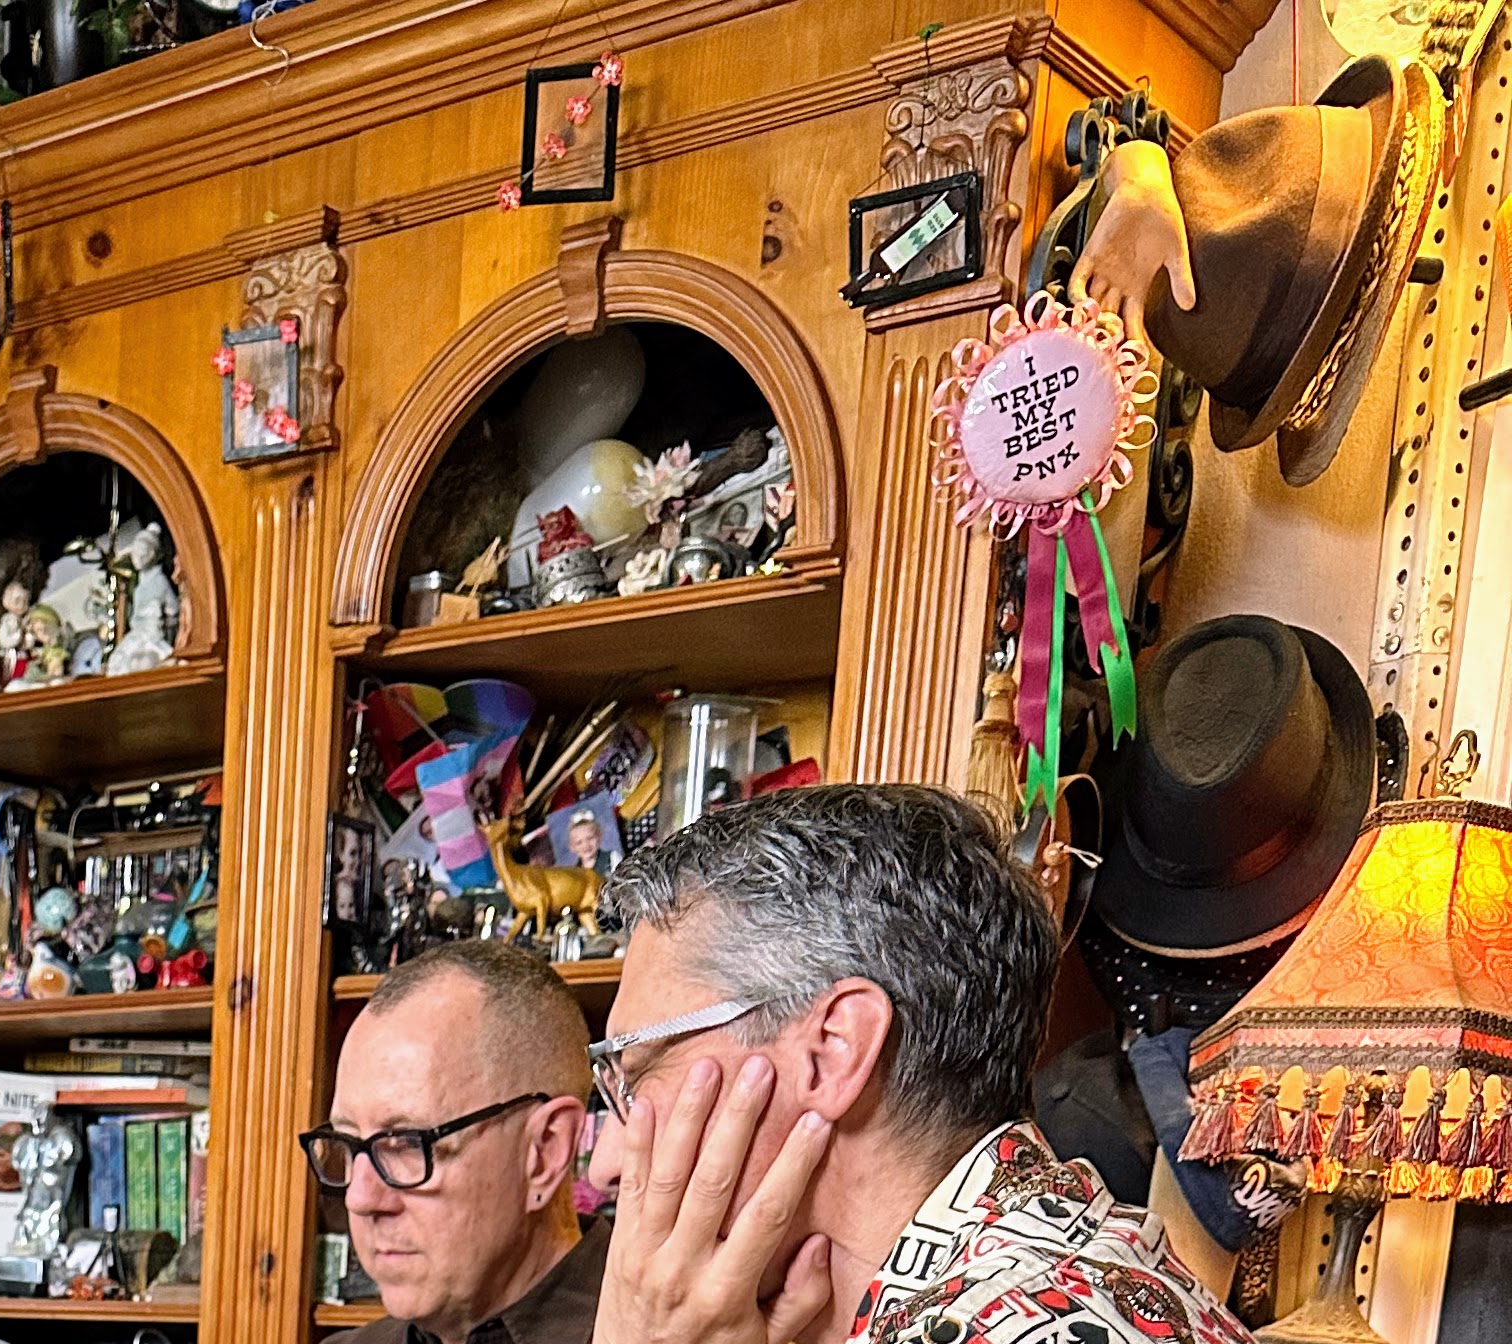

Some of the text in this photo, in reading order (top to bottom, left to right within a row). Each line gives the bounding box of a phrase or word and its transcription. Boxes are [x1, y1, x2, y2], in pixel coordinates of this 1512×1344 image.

[1025, 356, 1036, 377] I
[991, 365, 1079, 414] TRIED
[1003, 408, 1076, 459] BEST
[1011, 396, 1057, 431] MY
[1012, 441, 1081, 482] PNX
